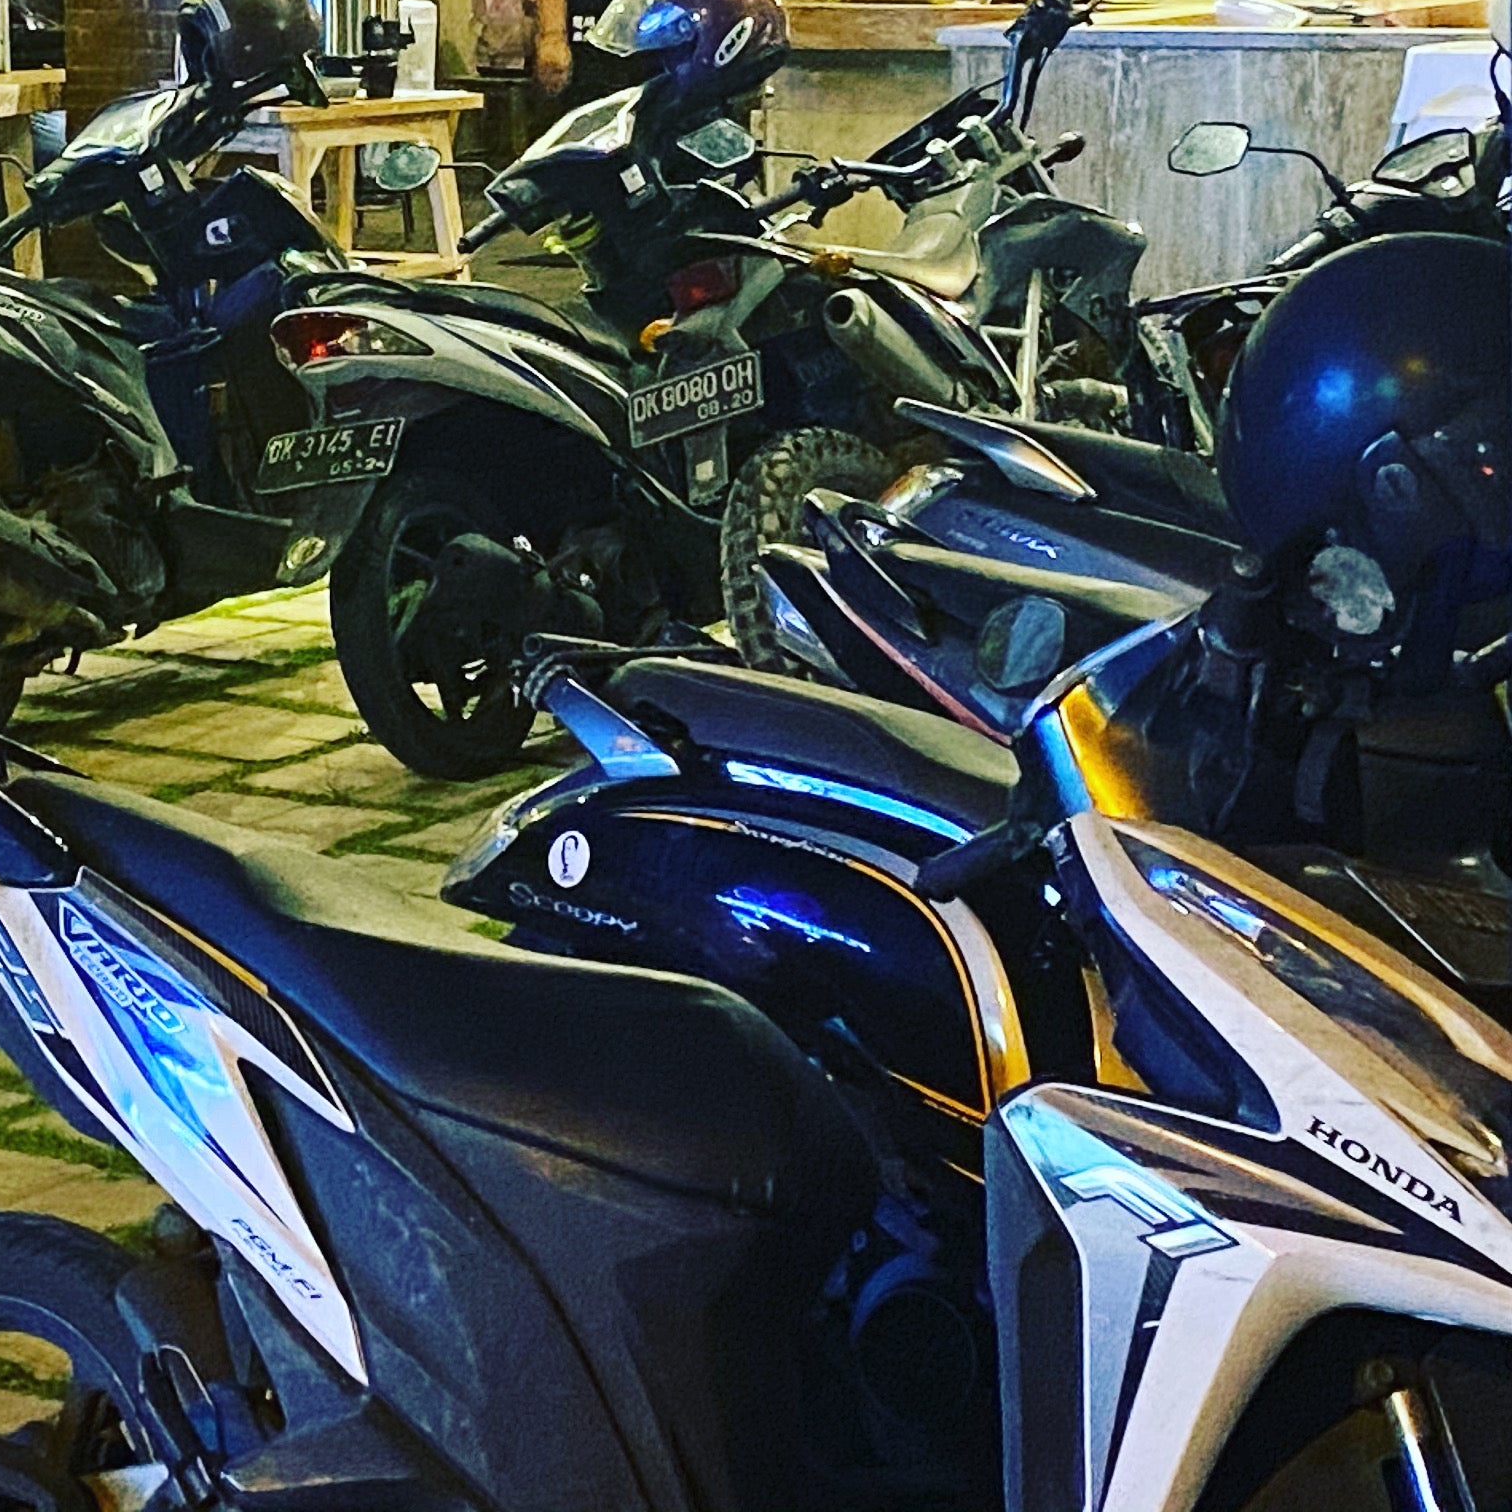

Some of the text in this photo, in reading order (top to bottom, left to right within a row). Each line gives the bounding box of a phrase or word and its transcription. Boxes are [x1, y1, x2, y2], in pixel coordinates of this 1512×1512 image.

[633, 392, 661, 422] DK
[661, 371, 718, 412] 8080
[1305, 1115, 1463, 1225] HONDA
